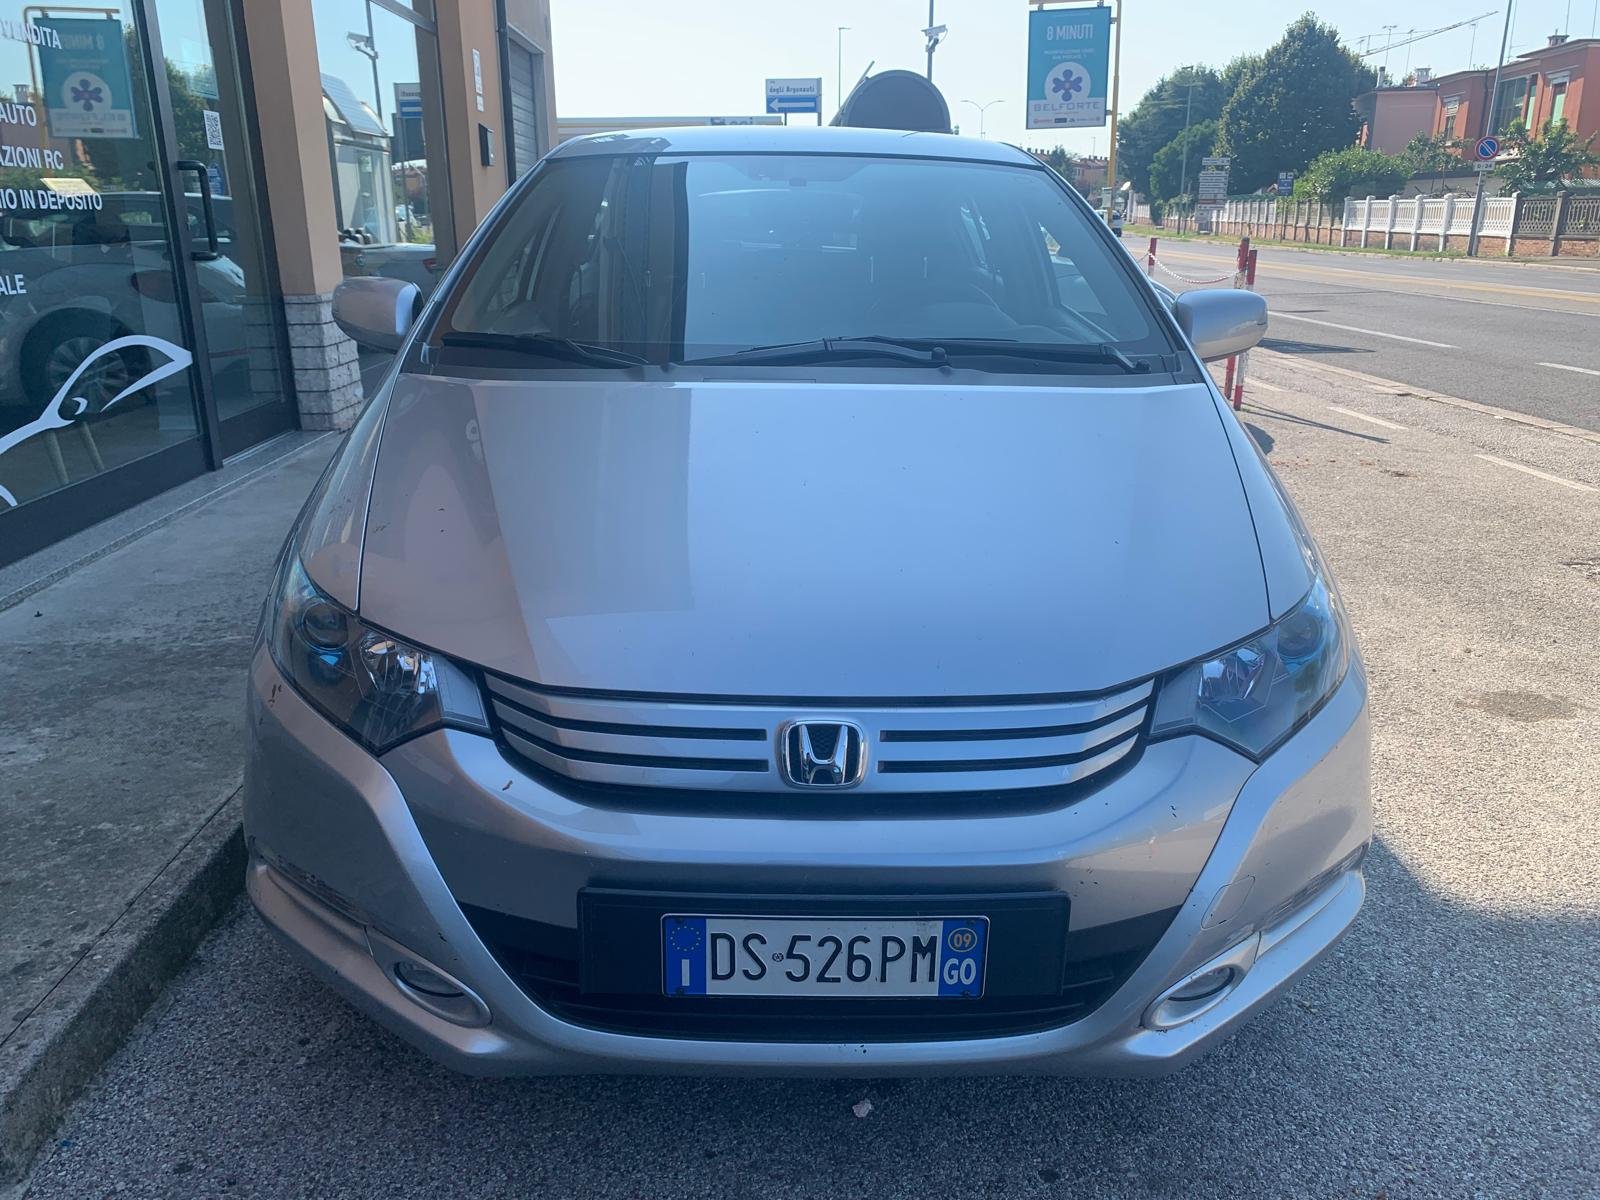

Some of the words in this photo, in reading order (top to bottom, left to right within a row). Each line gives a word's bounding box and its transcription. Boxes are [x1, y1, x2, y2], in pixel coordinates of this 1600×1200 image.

[1046, 25, 1054, 41] 8
[1056, 23, 1094, 41] MINUTI
[1033, 101, 1100, 112] BELFORTE
[43, 149, 64, 170] RC
[19, 189, 36, 209] IN
[37, 190, 103, 210] DEPOSITO
[952, 931, 972, 947] 09
[710, 932, 767, 981] DS
[943, 957, 977, 986] GO
